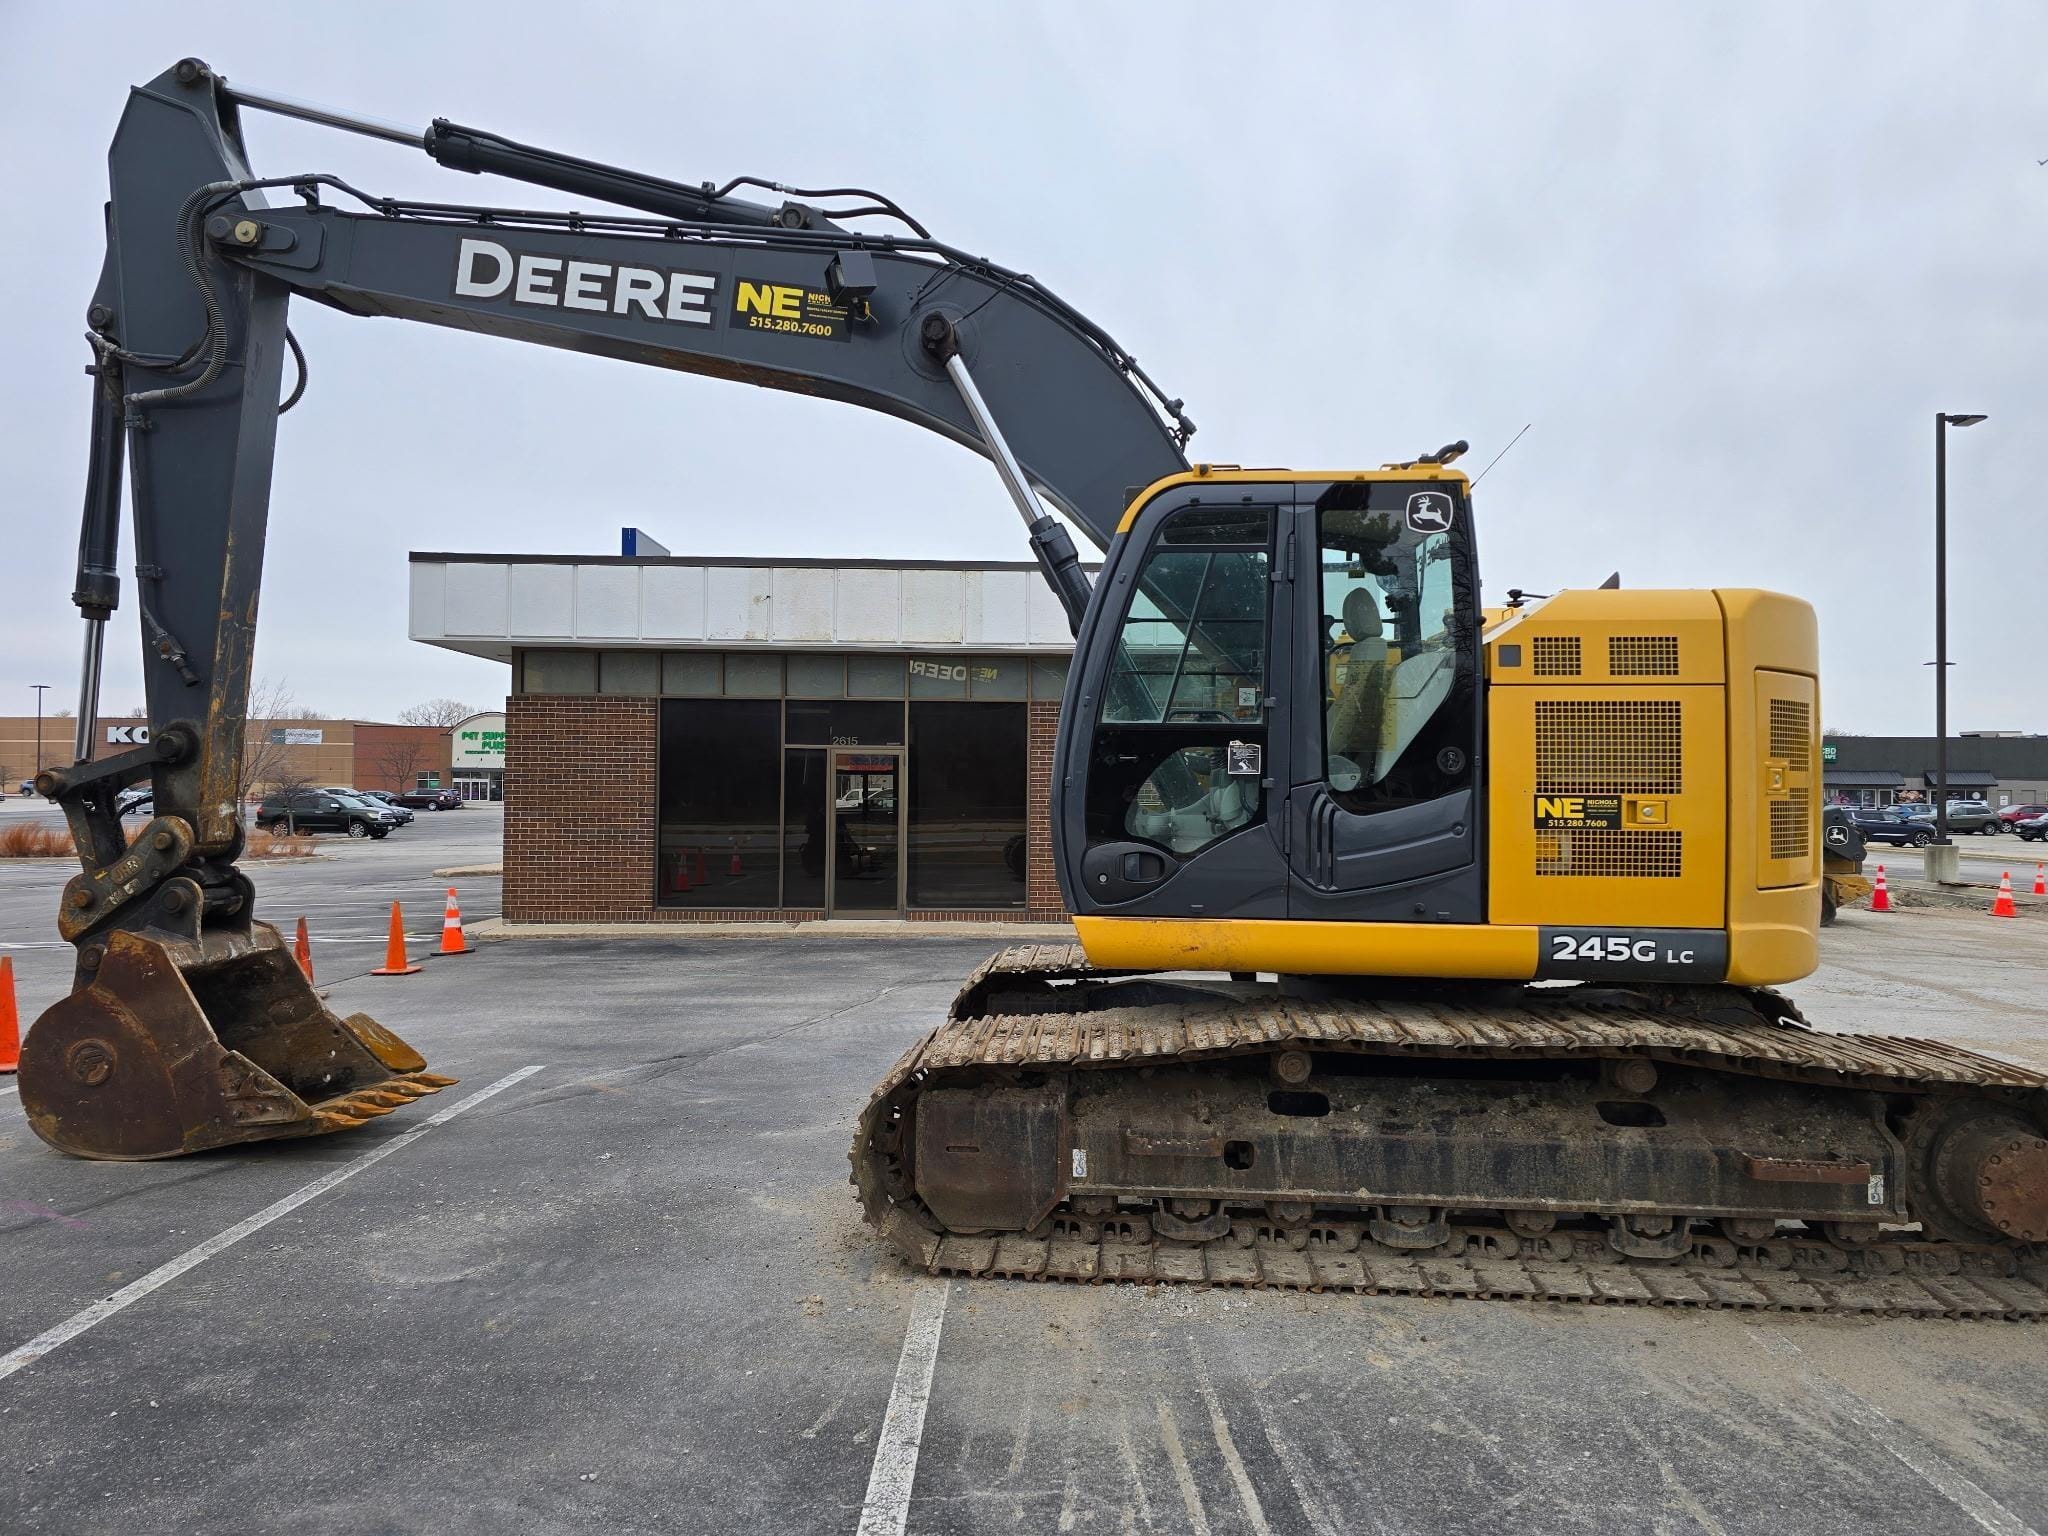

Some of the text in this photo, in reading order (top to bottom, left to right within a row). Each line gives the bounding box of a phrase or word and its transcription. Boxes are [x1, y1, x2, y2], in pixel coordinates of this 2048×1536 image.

[455, 238, 716, 324] DEERE
[737, 281, 804, 319] NE
[749, 316, 832, 337] 515.280.7600
[832, 736, 859, 746] 2615
[1537, 797, 1585, 819] NE
[1547, 819, 1608, 827] 515.280.7600
[1553, 935, 1694, 964] 245G LC
